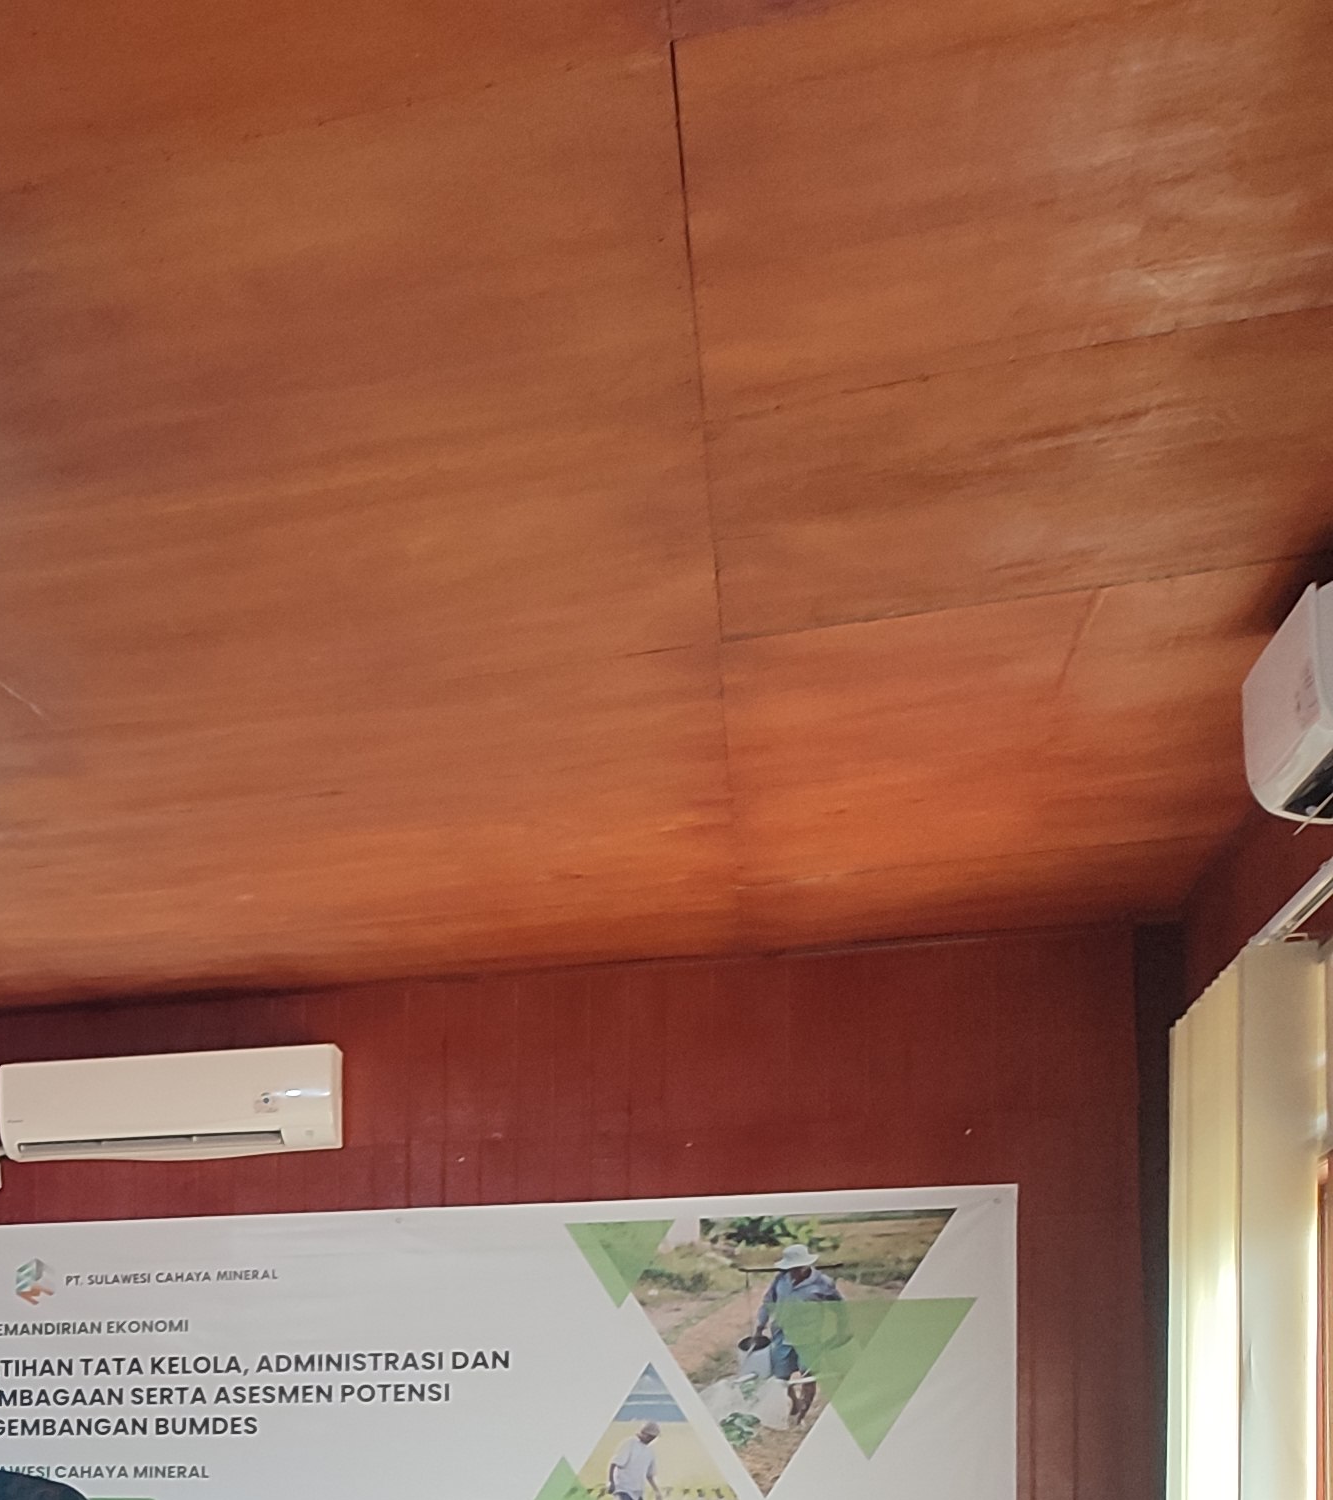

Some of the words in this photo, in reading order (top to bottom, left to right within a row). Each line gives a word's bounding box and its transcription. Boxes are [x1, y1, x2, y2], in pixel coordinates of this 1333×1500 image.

[65, 1275, 83, 1286] PT.
[87, 1273, 151, 1286] SULAWESI
[155, 1271, 212, 1284] CAHAYA
[216, 1268, 278, 1282] MINERAL
[106, 1319, 189, 1334] EKONOMI
[79, 1357, 144, 1377] TATA
[150, 1355, 250, 1377] KELOLA,
[256, 1351, 444, 1375] ADMINISTRASI
[451, 1350, 510, 1370] DAN
[130, 1386, 207, 1406] SERTA
[213, 1384, 333, 1405] ASESMEN
[340, 1382, 450, 1403] POTENSI
[154, 1416, 258, 1436] BUMDES
[54, 1465, 129, 1479] CAHAYA
[133, 1465, 210, 1479] MINERAL
